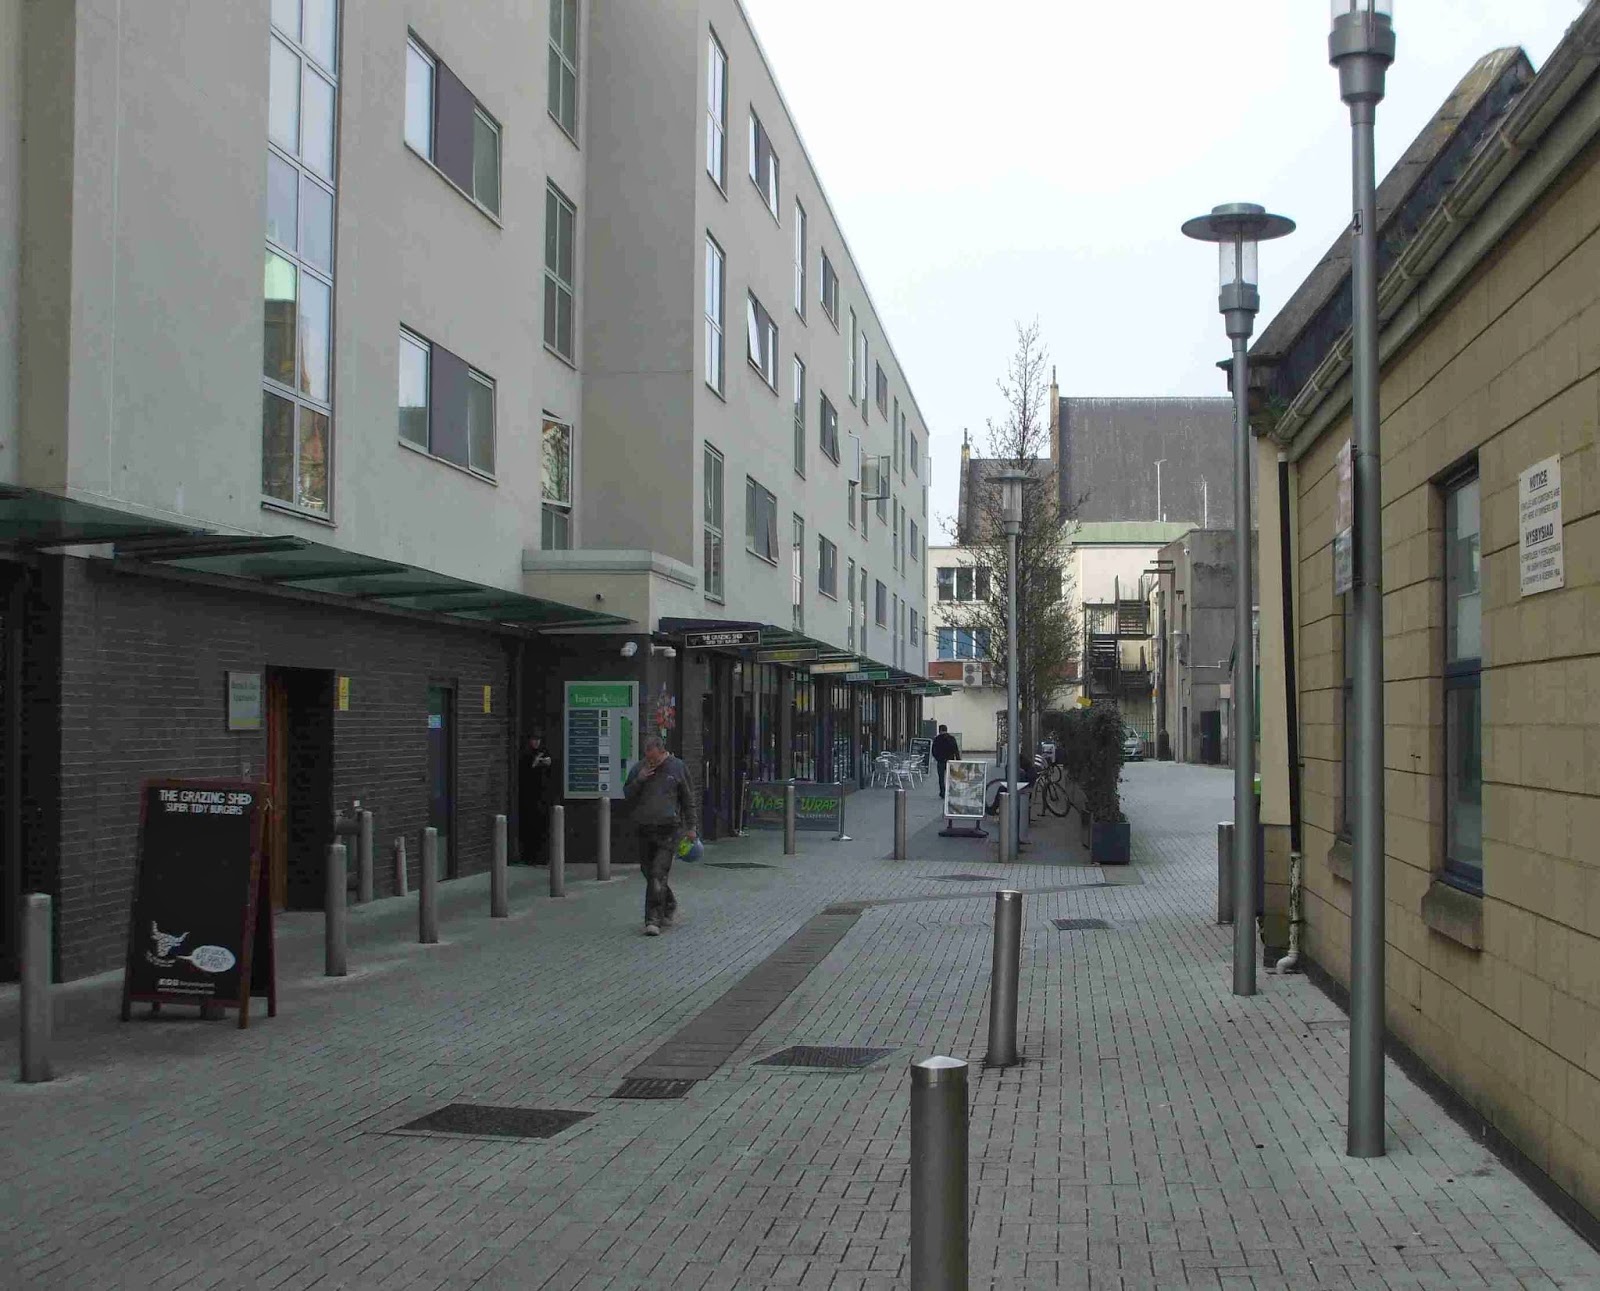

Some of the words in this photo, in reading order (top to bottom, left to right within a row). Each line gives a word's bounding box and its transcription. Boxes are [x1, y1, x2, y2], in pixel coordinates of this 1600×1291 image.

[1529, 470, 1548, 488] NOTICE
[1526, 523, 1554, 545] HYSBYSIAD
[159, 789, 178, 801] THE
[180, 790, 226, 804] GRAZING
[227, 793, 252, 805] SHED
[800, 797, 837, 812] WRAP
[166, 802, 188, 812] SUPER
[190, 804, 209, 813] TIDY
[210, 805, 243, 815] BURGERS
